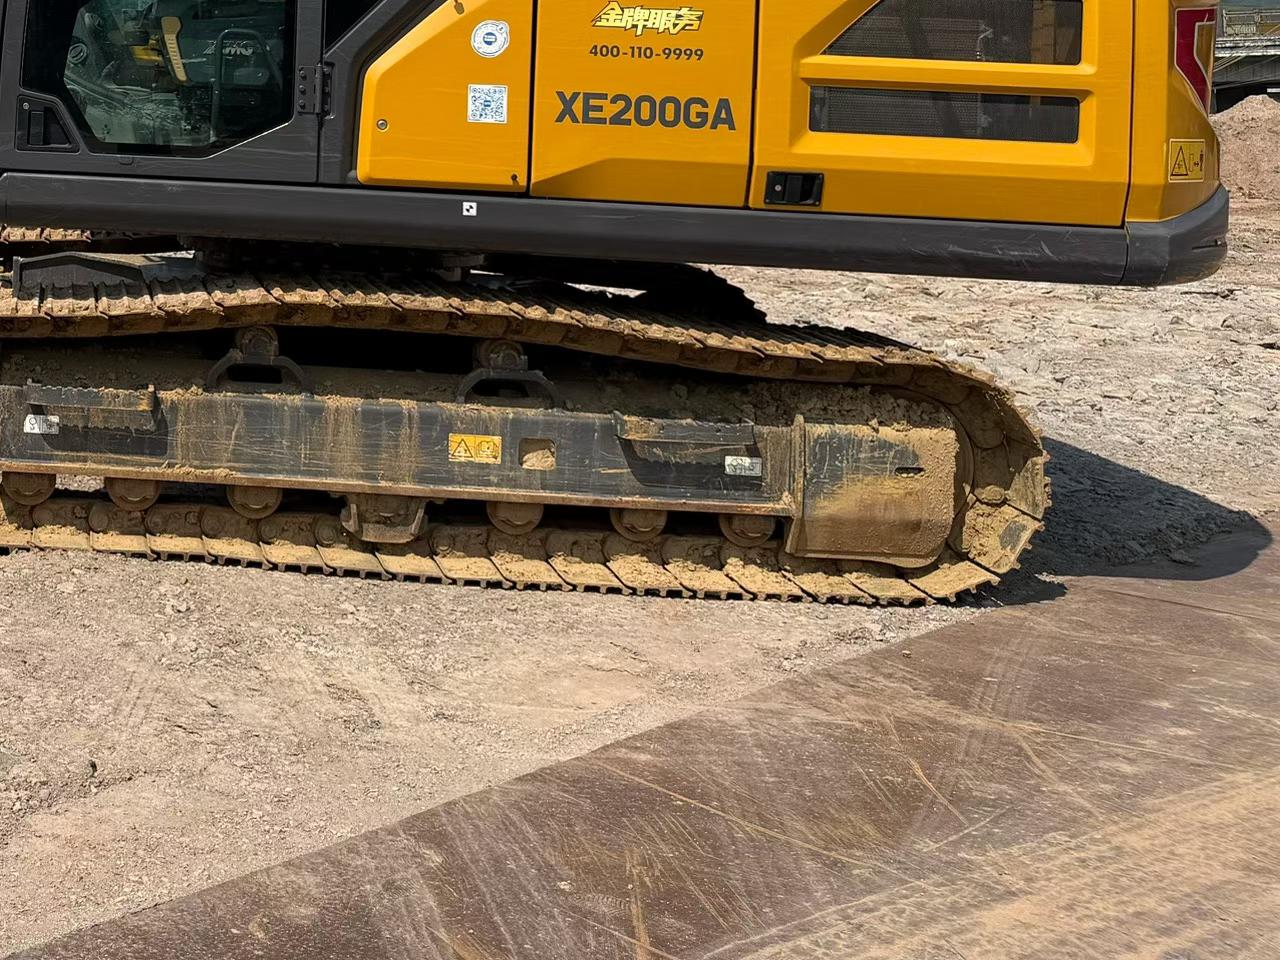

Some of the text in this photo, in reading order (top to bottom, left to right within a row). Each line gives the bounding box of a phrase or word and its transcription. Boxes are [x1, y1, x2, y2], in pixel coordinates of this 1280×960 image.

[591, 1, 705, 37] 金牌服务
[589, 44, 704, 61] 400-110-9999
[555, 90, 737, 131] XE200GA
